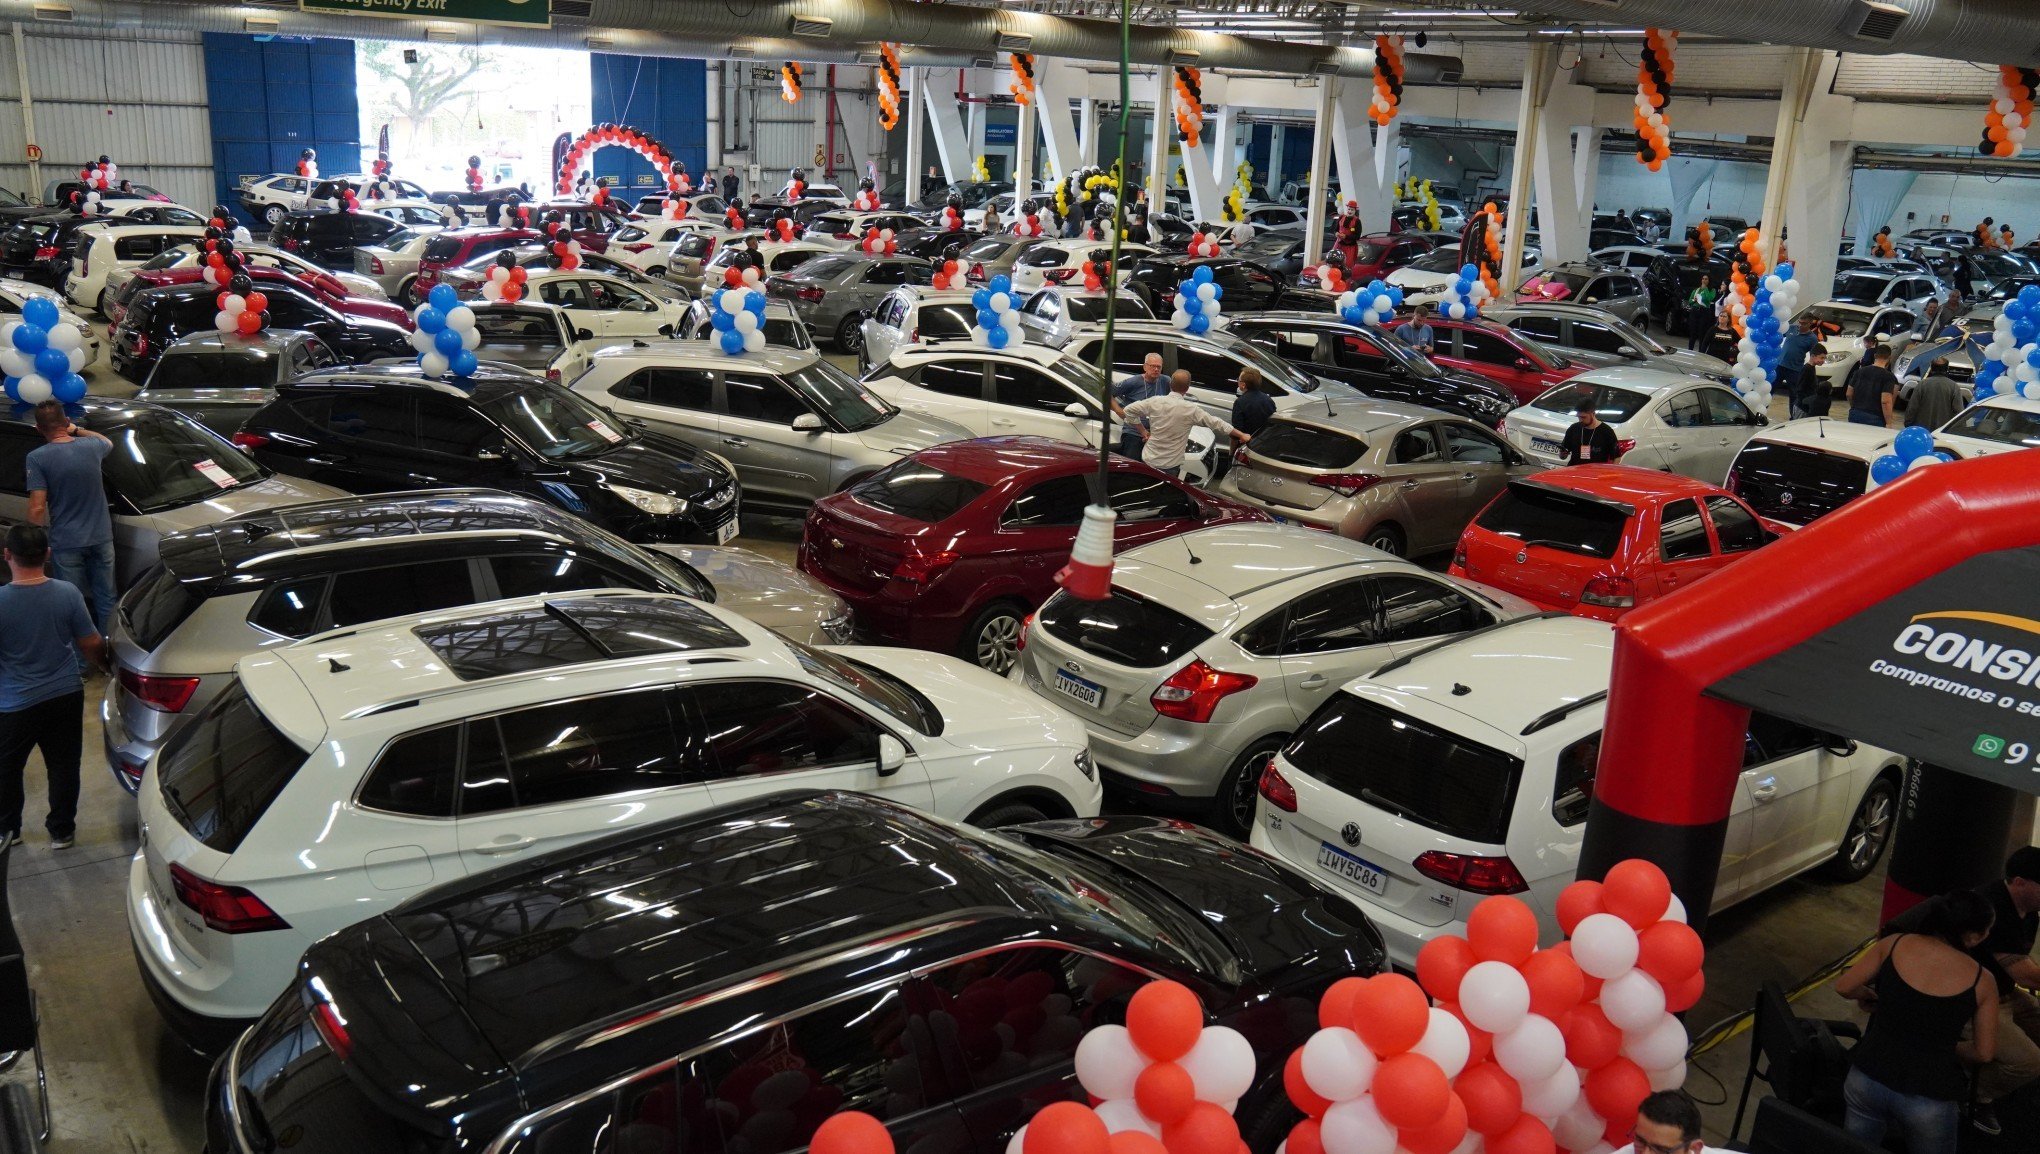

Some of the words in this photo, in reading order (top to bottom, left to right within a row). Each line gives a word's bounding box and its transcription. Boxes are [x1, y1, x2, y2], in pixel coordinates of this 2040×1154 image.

[334, 0, 411, 9] gency
[1893, 624, 2040, 691] CONSI
[1058, 677, 1096, 703] IYX2G08
[1869, 659, 1997, 703] Compramos
[1998, 696, 2015, 708] o
[2004, 742, 2029, 764] 9
[1322, 847, 1378, 888] IWY5C86
